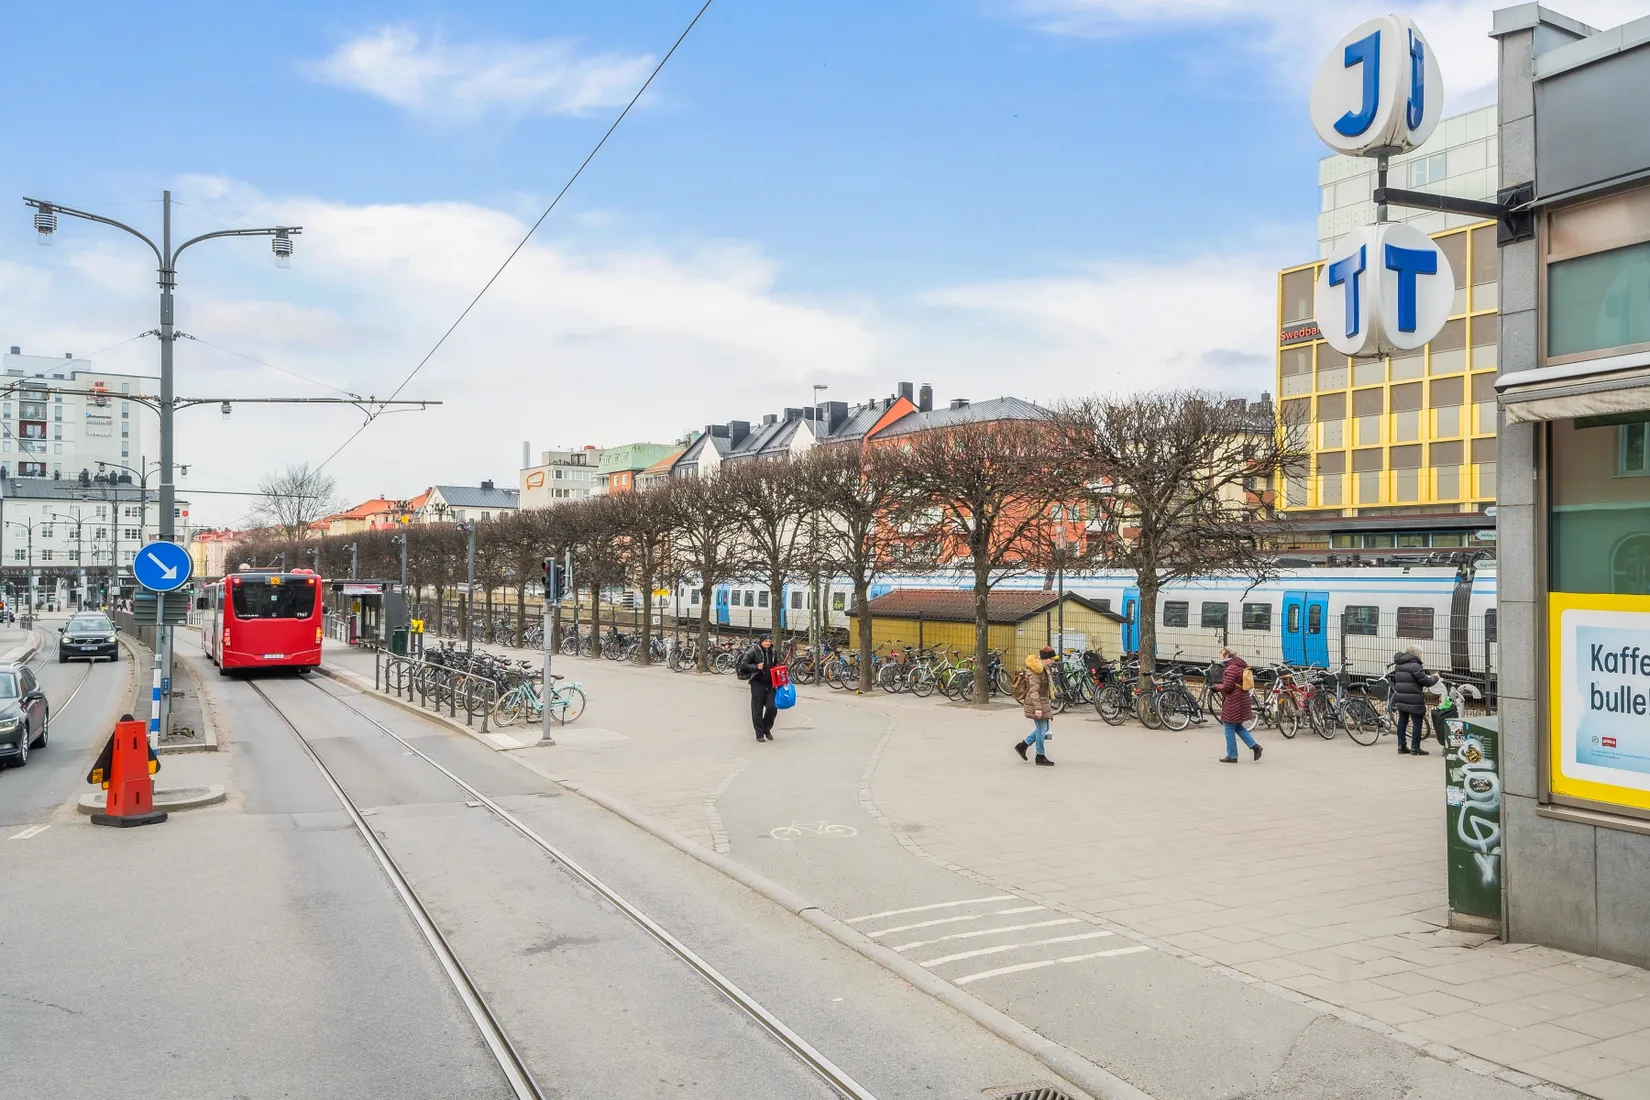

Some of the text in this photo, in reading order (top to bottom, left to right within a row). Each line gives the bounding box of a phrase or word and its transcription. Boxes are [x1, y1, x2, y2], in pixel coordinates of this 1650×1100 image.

[1334, 30, 1380, 136] J
[1407, 28, 1424, 131] J
[1329, 244, 1367, 338] T
[1385, 244, 1437, 332] T
[1590, 643, 1650, 677] Kaffe
